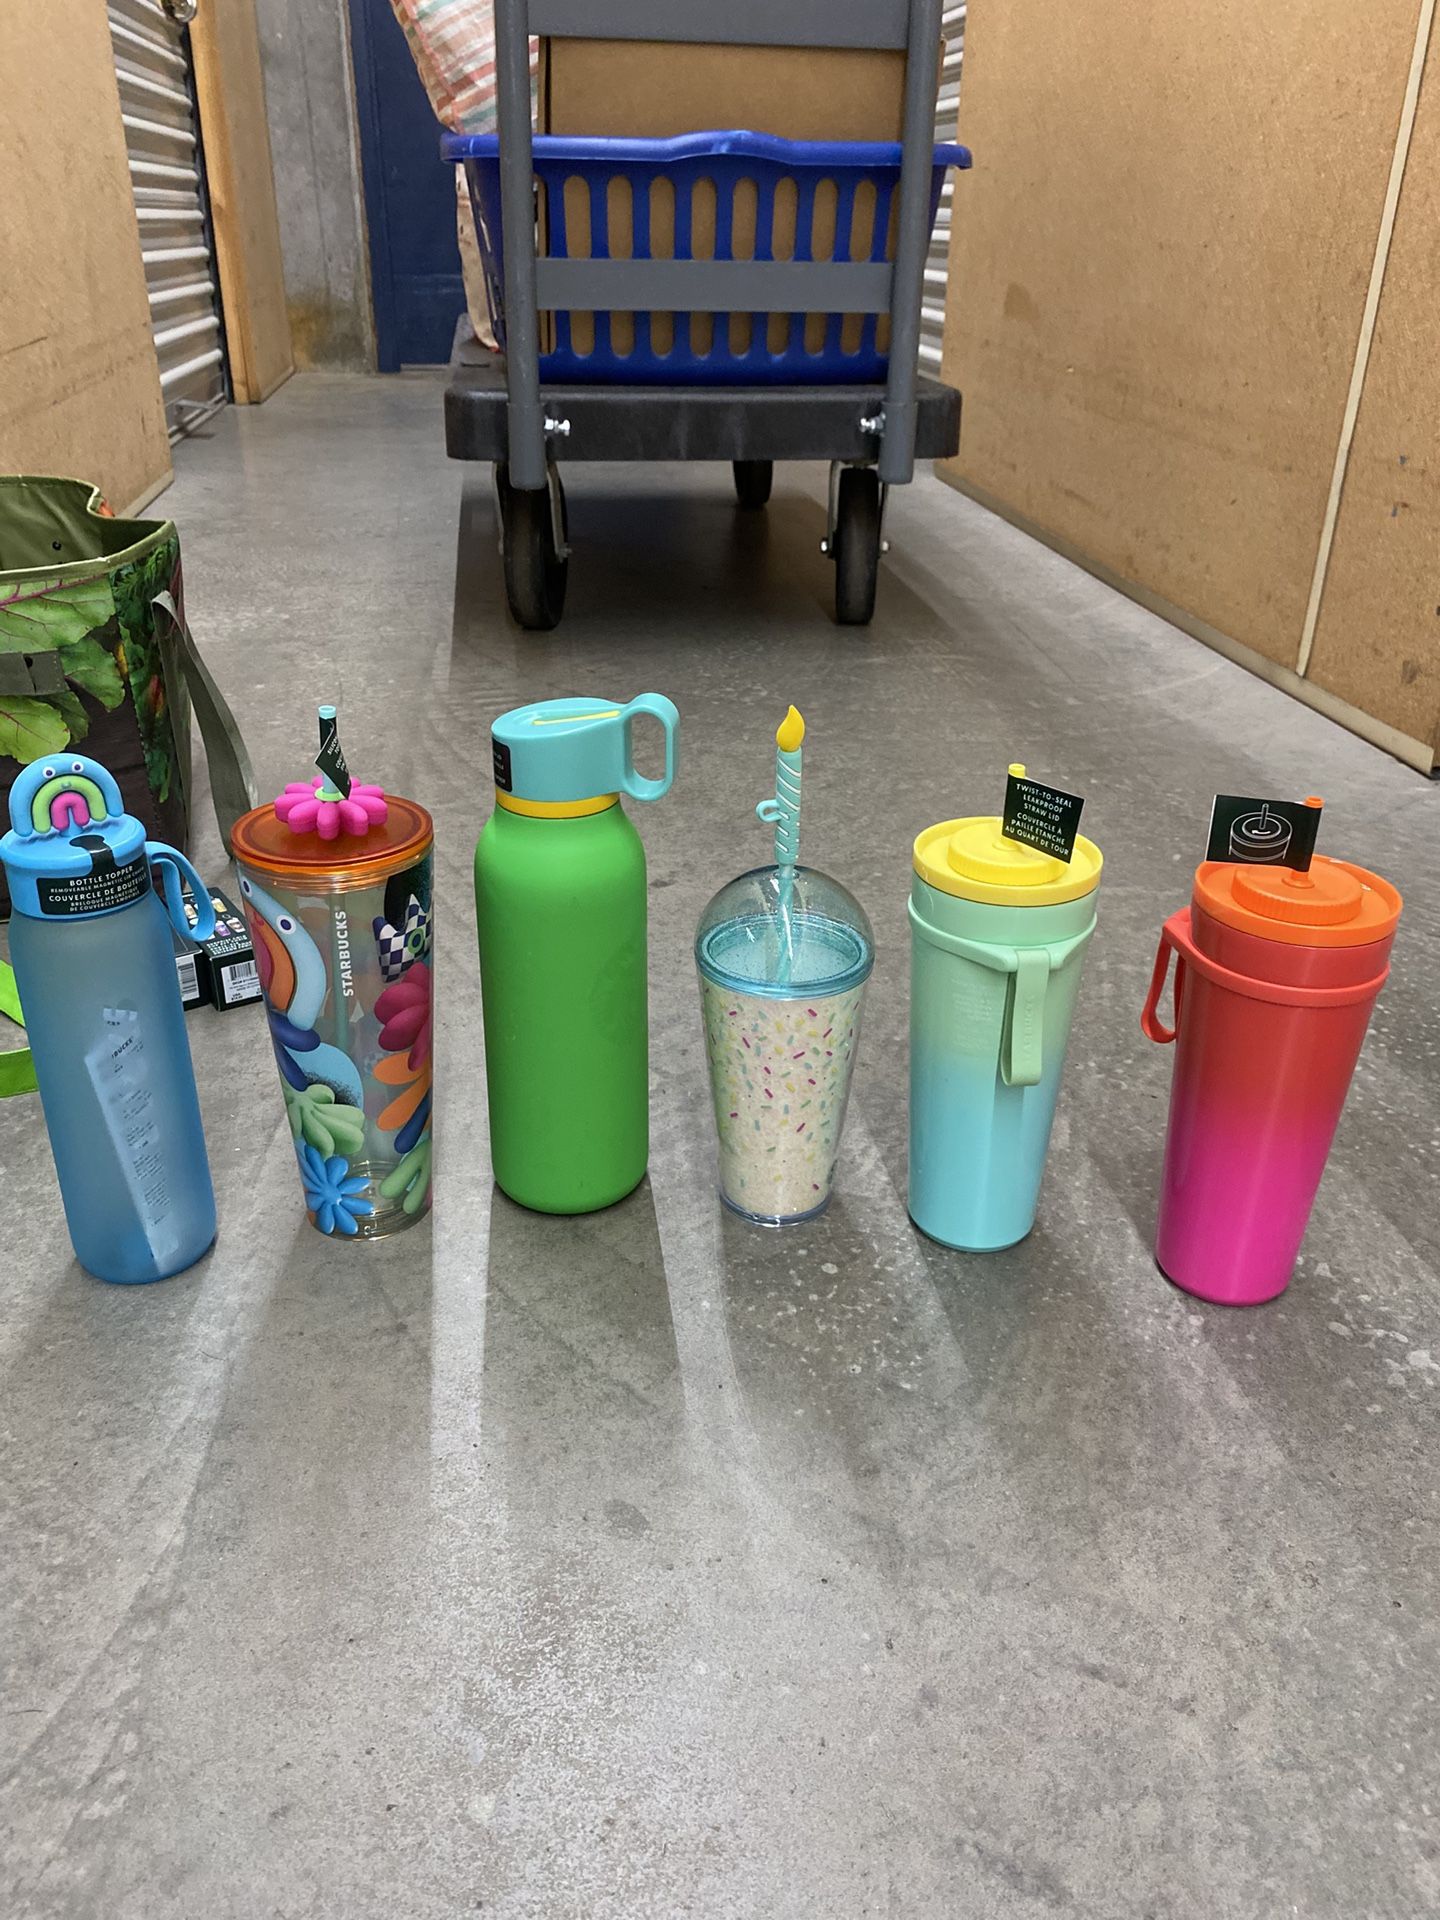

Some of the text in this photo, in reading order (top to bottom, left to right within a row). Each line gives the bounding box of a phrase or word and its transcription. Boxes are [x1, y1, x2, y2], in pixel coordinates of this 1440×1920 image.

[1016, 783, 1072, 808] TWIST-TO-SEAL
[1023, 794, 1064, 813] LEAKPROOF
[1016, 812, 1056, 832] COUVERCLE
[1023, 803, 1060, 821] STRAW LID
[1011, 819, 1034, 832] PAILLE
[1005, 825, 1070, 856] AU QUART DE TOUR
[69, 865, 133, 887] BOTTLE TOPPER
[48, 890, 102, 902] COUVERCLE
[104, 887, 115, 896] DE
[334, 910, 354, 997] STARBUCKS
